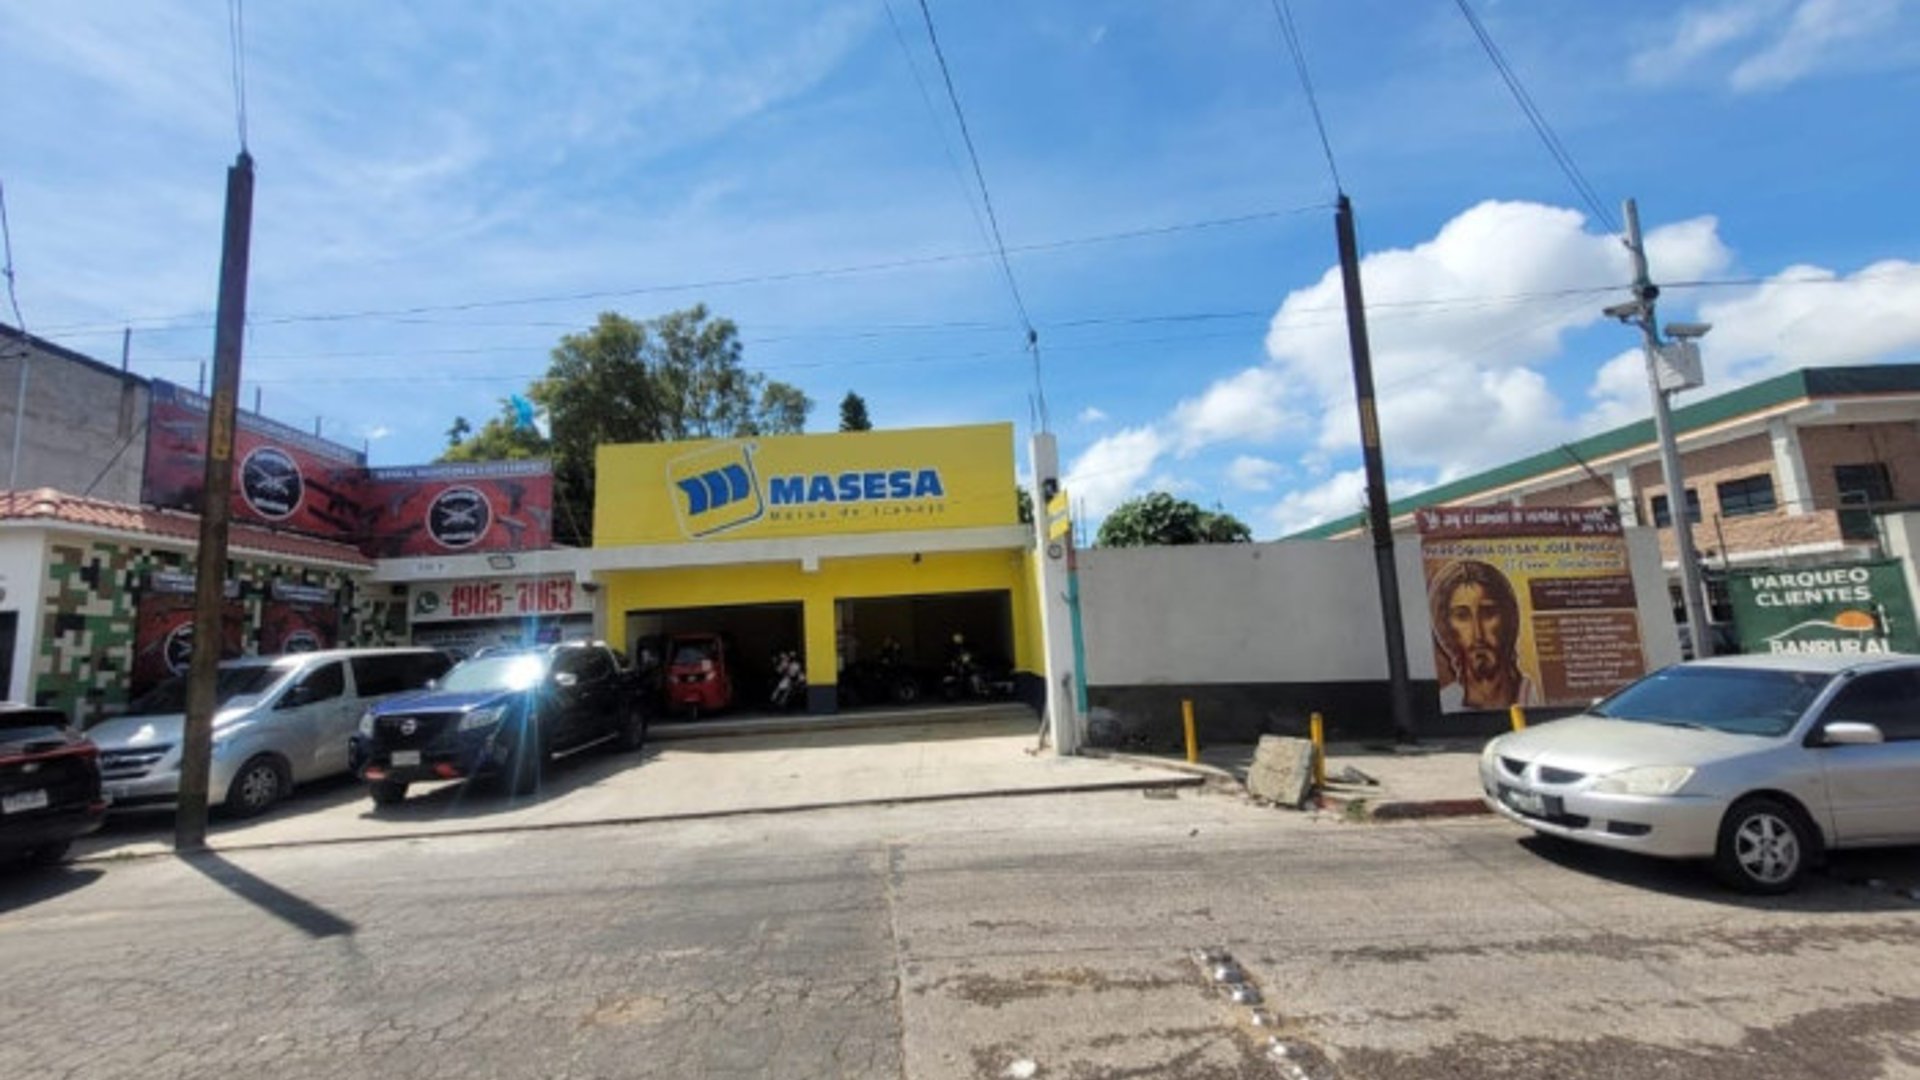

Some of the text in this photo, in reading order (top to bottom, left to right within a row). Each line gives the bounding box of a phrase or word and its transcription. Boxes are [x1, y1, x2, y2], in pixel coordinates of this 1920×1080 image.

[769, 469, 944, 505] MASESA
[1751, 567, 1869, 590] PARQUEO
[1755, 585, 1872, 607] CLIENTES
